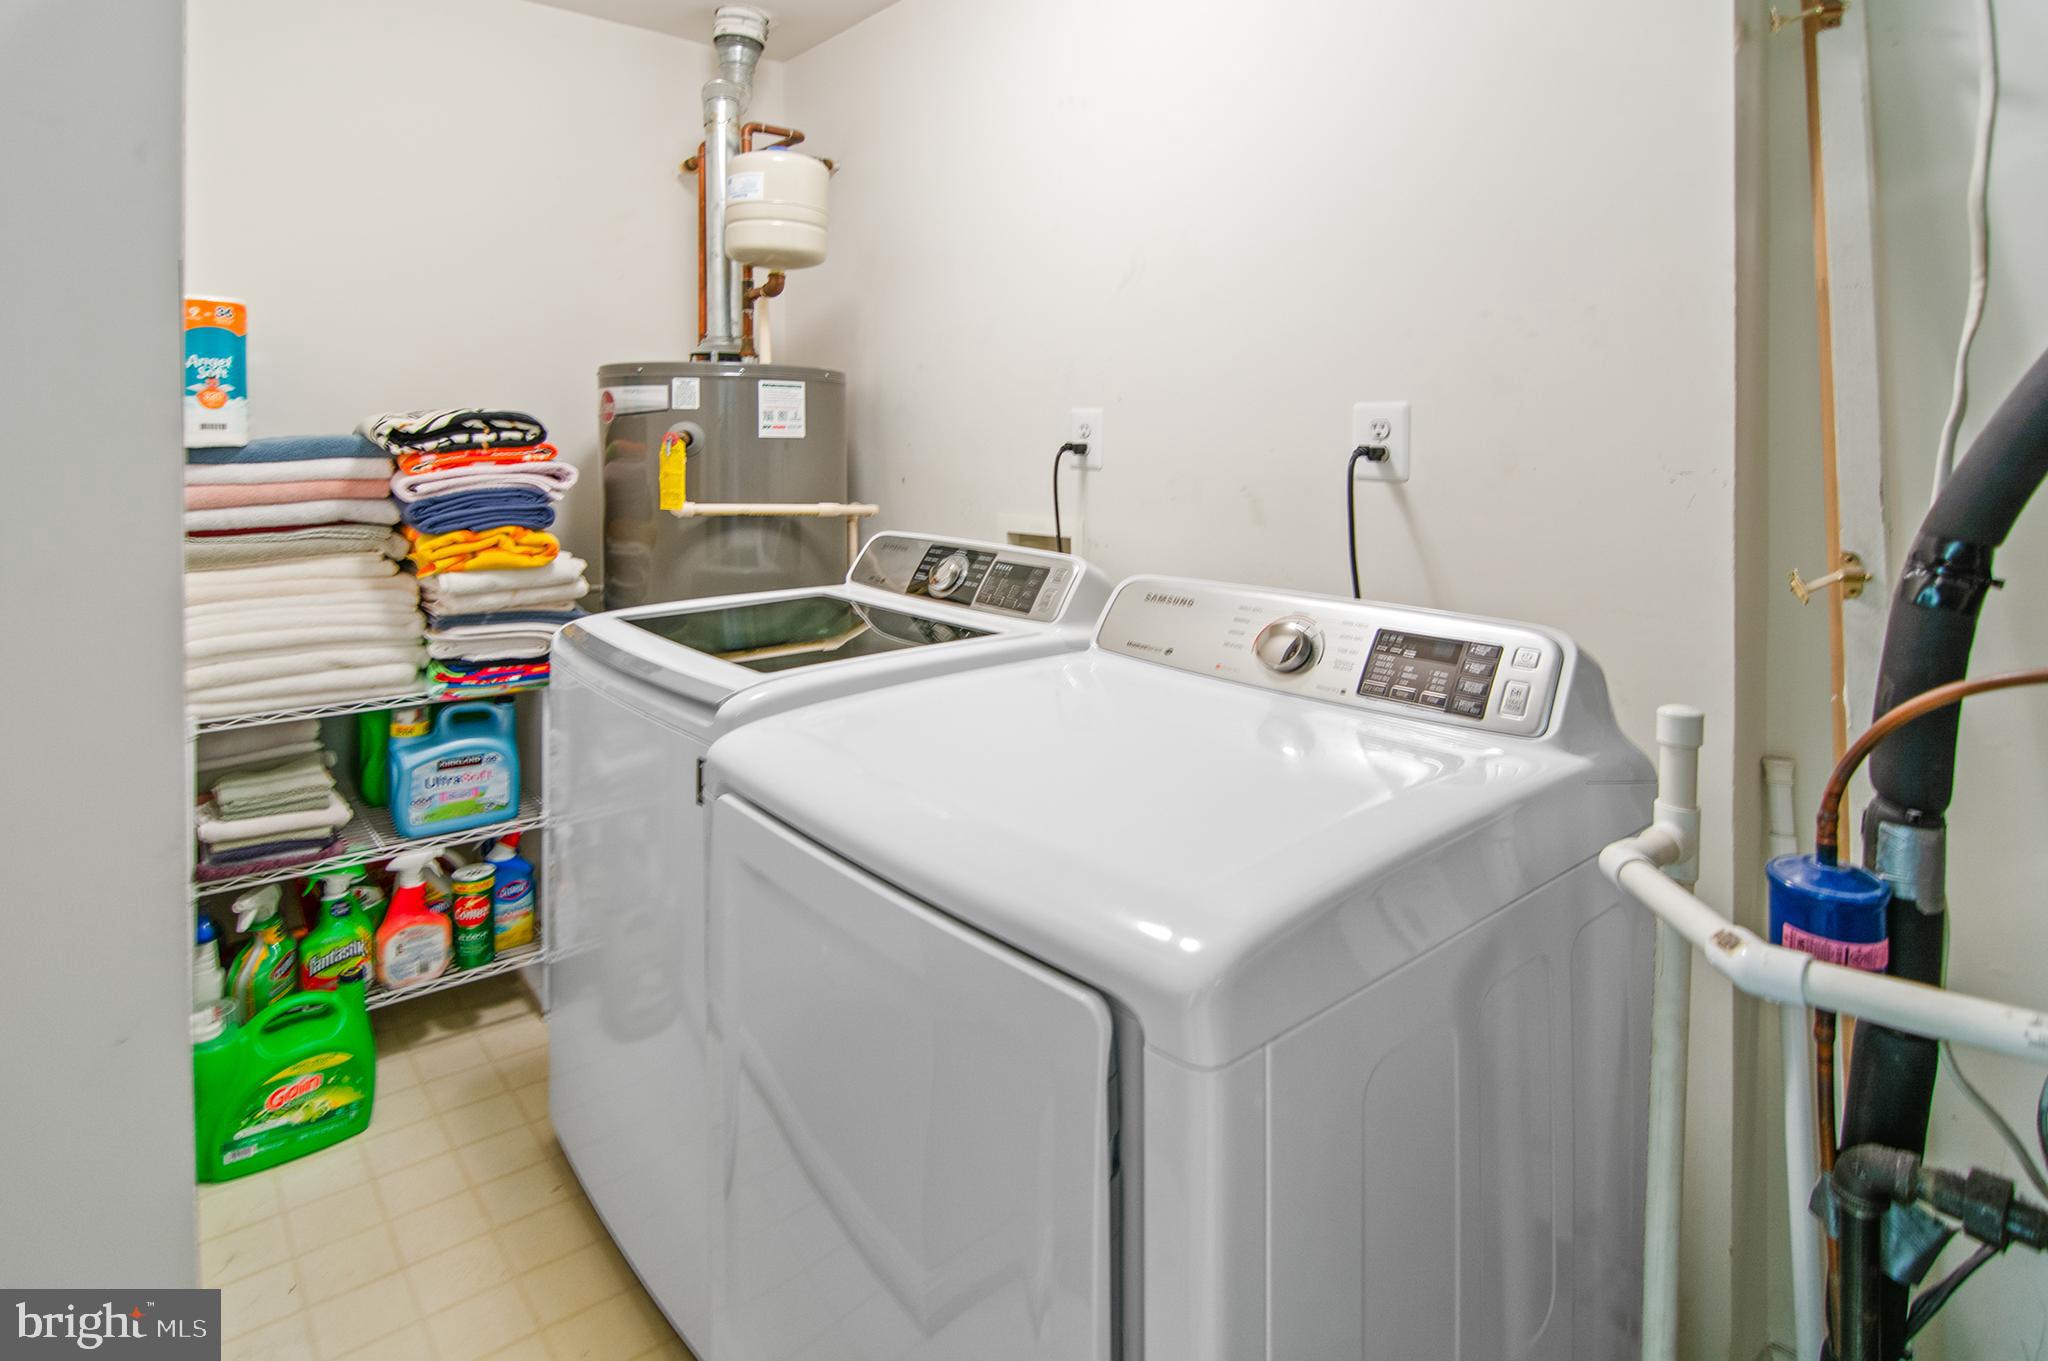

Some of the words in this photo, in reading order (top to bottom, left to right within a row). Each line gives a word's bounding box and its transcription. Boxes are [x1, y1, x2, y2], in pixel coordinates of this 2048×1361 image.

[185, 354, 234, 369] Angel
[196, 366, 229, 379] Soft
[1144, 592, 1196, 608] SAMSUNG
[455, 904, 490, 920] Comet
[265, 1074, 324, 1112] Gain
